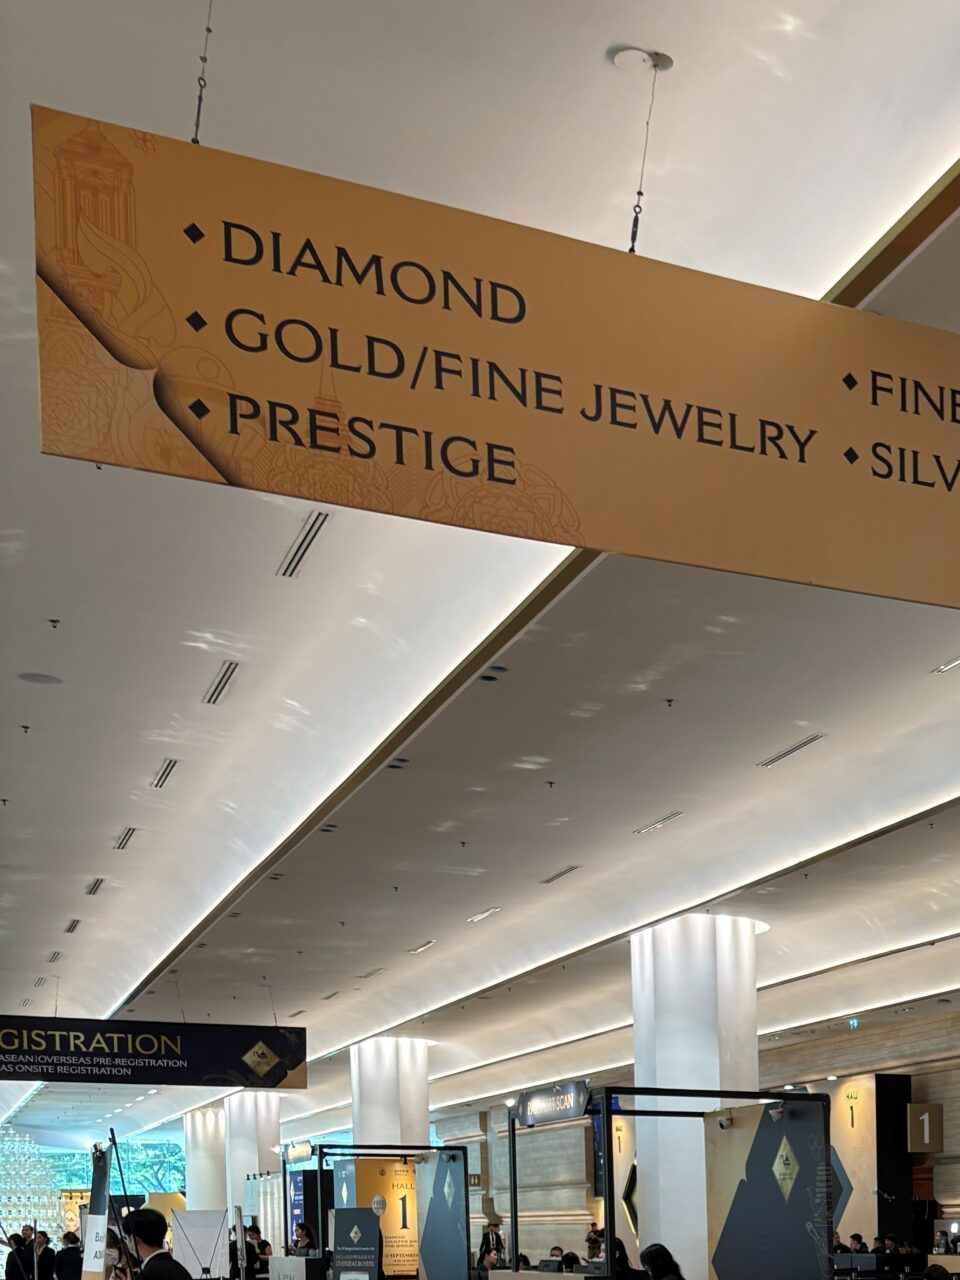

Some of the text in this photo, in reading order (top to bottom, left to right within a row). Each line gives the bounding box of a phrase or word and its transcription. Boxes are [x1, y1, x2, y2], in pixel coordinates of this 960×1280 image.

[221, 219, 527, 326] DIAMOND
[225, 307, 818, 465] GOLD/FINE JEWELRY
[226, 393, 519, 486] PRESTIGE
[0, 1028, 182, 1056] GISTRATION
[15, 1064, 55, 1074] ONSITE
[57, 1065, 132, 1076] REGISTRATION
[93, 1056, 188, 1069] PRE-REGISTRATION
[556, 1093, 574, 1111] SCAN
[919, 1111, 930, 1145] 1
[399, 1194, 411, 1230] 1
